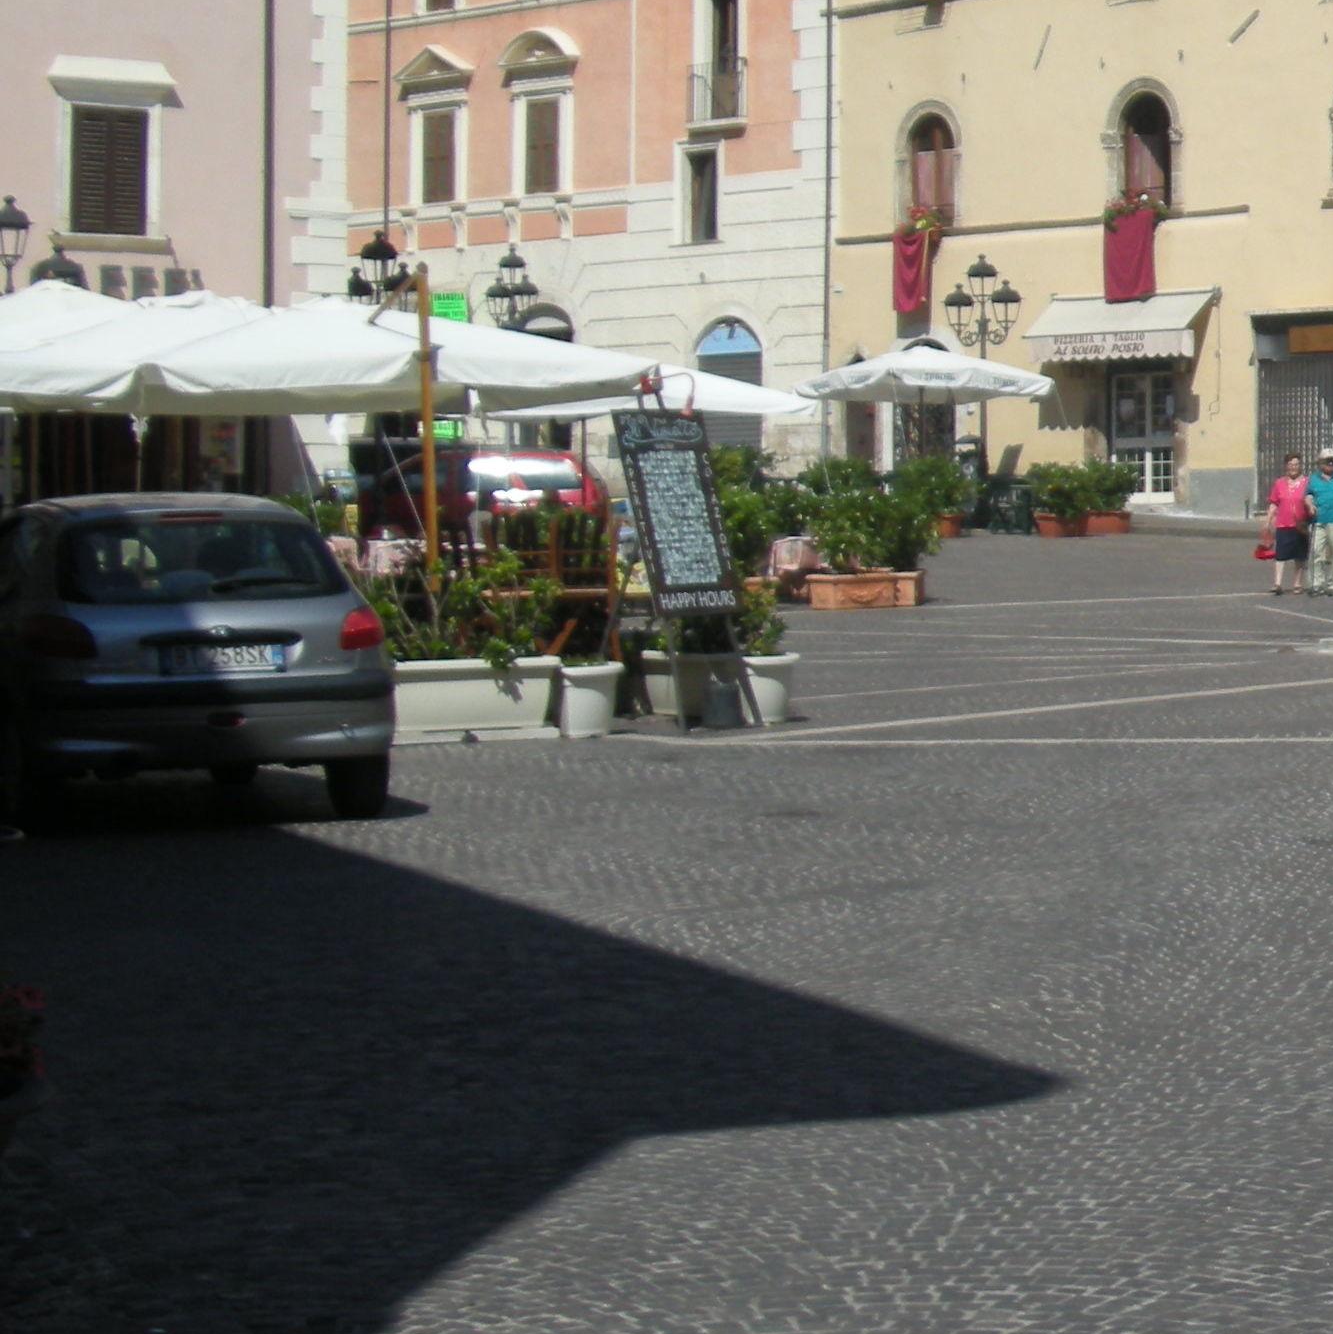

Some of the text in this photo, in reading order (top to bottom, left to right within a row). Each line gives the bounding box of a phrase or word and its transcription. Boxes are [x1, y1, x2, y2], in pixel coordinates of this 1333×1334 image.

[1054, 335, 1095, 345] PIZZERIA
[1113, 331, 1146, 342] TAGLIO
[1111, 342, 1144, 353] POSTO
[659, 590, 736, 609] HAPPY HOURS
